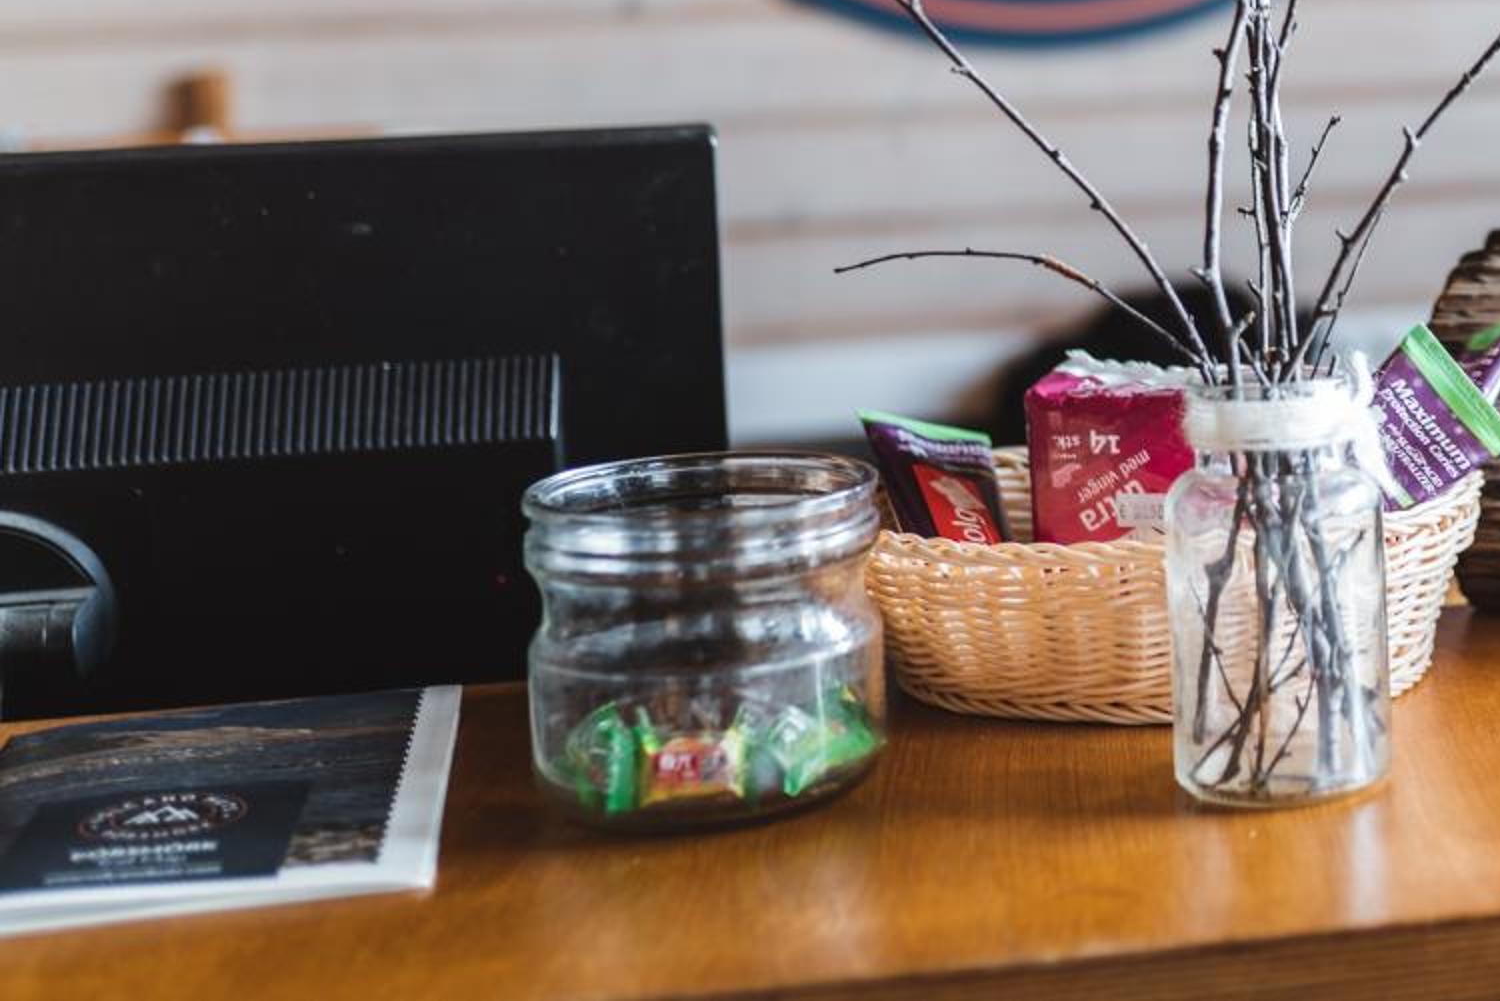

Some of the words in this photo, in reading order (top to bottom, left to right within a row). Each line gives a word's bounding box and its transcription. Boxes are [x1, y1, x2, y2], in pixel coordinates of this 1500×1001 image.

[1089, 429, 1121, 454] 14
[1379, 387, 1432, 447] Protection
[1390, 378, 1472, 471] Maximum
[1078, 479, 1145, 532] utra
